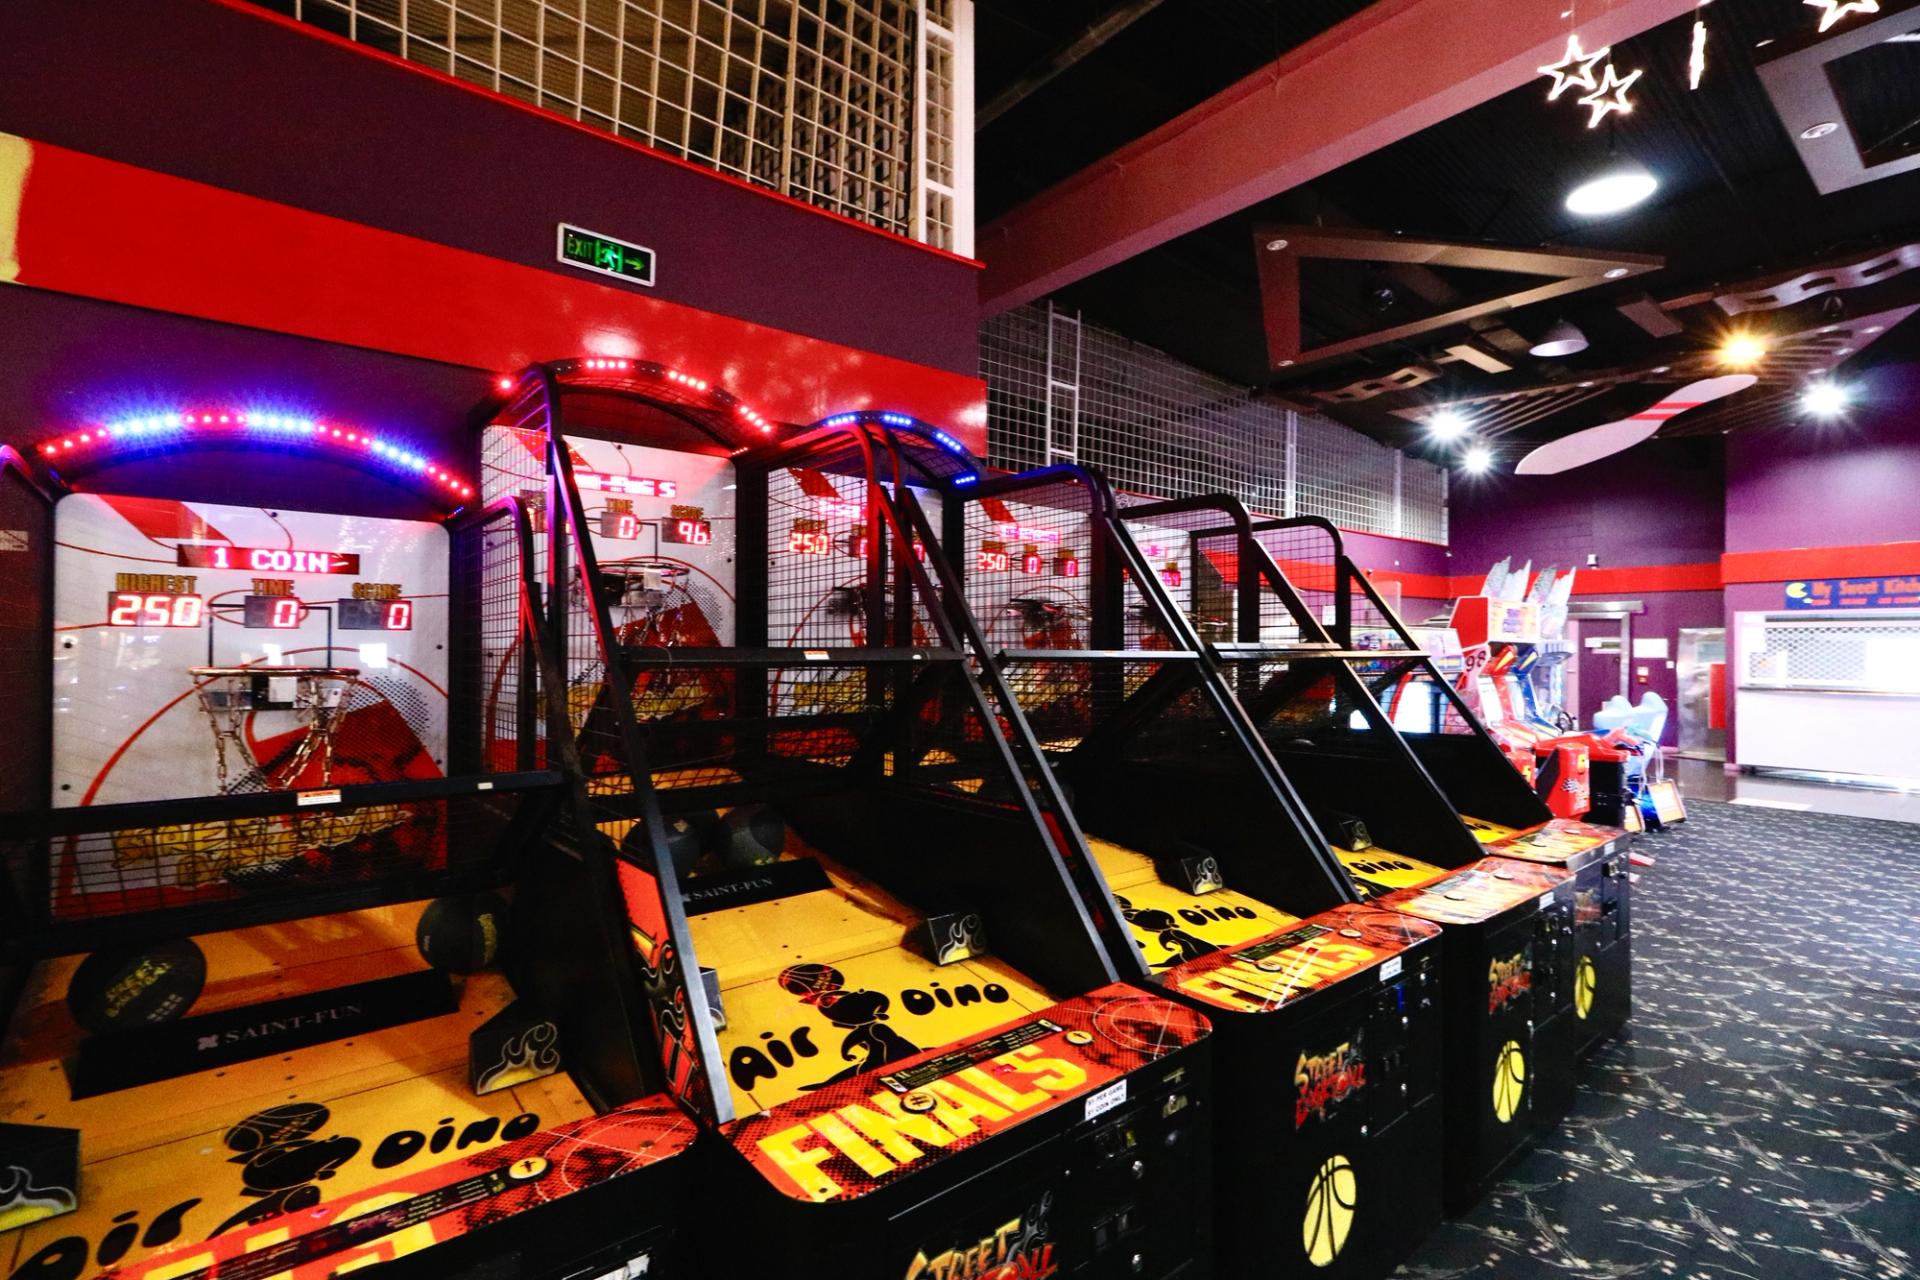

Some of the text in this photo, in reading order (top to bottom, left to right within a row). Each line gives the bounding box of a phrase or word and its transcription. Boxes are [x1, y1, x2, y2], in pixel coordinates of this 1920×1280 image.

[567, 237, 593, 258] EXIT
[618, 516, 636, 539] 0
[789, 532, 828, 555] 250
[213, 548, 329, 573] 1 COIN
[977, 552, 1008, 571] 250
[116, 573, 197, 593] HIGHEST
[252, 578, 294, 597] TIME
[110, 595, 201, 627] 250
[272, 600, 298, 628] 0
[386, 603, 410, 631] 0
[692, 877, 774, 900] SAINT-FUN
[1177, 904, 1258, 927] Dino
[225, 1004, 363, 1045] SAINT-FUN
[729, 1025, 820, 1092] Air
[900, 981, 1010, 1016] Dino
[755, 1044, 1087, 1202] FINALS
[371, 1116, 541, 1169] Dino
